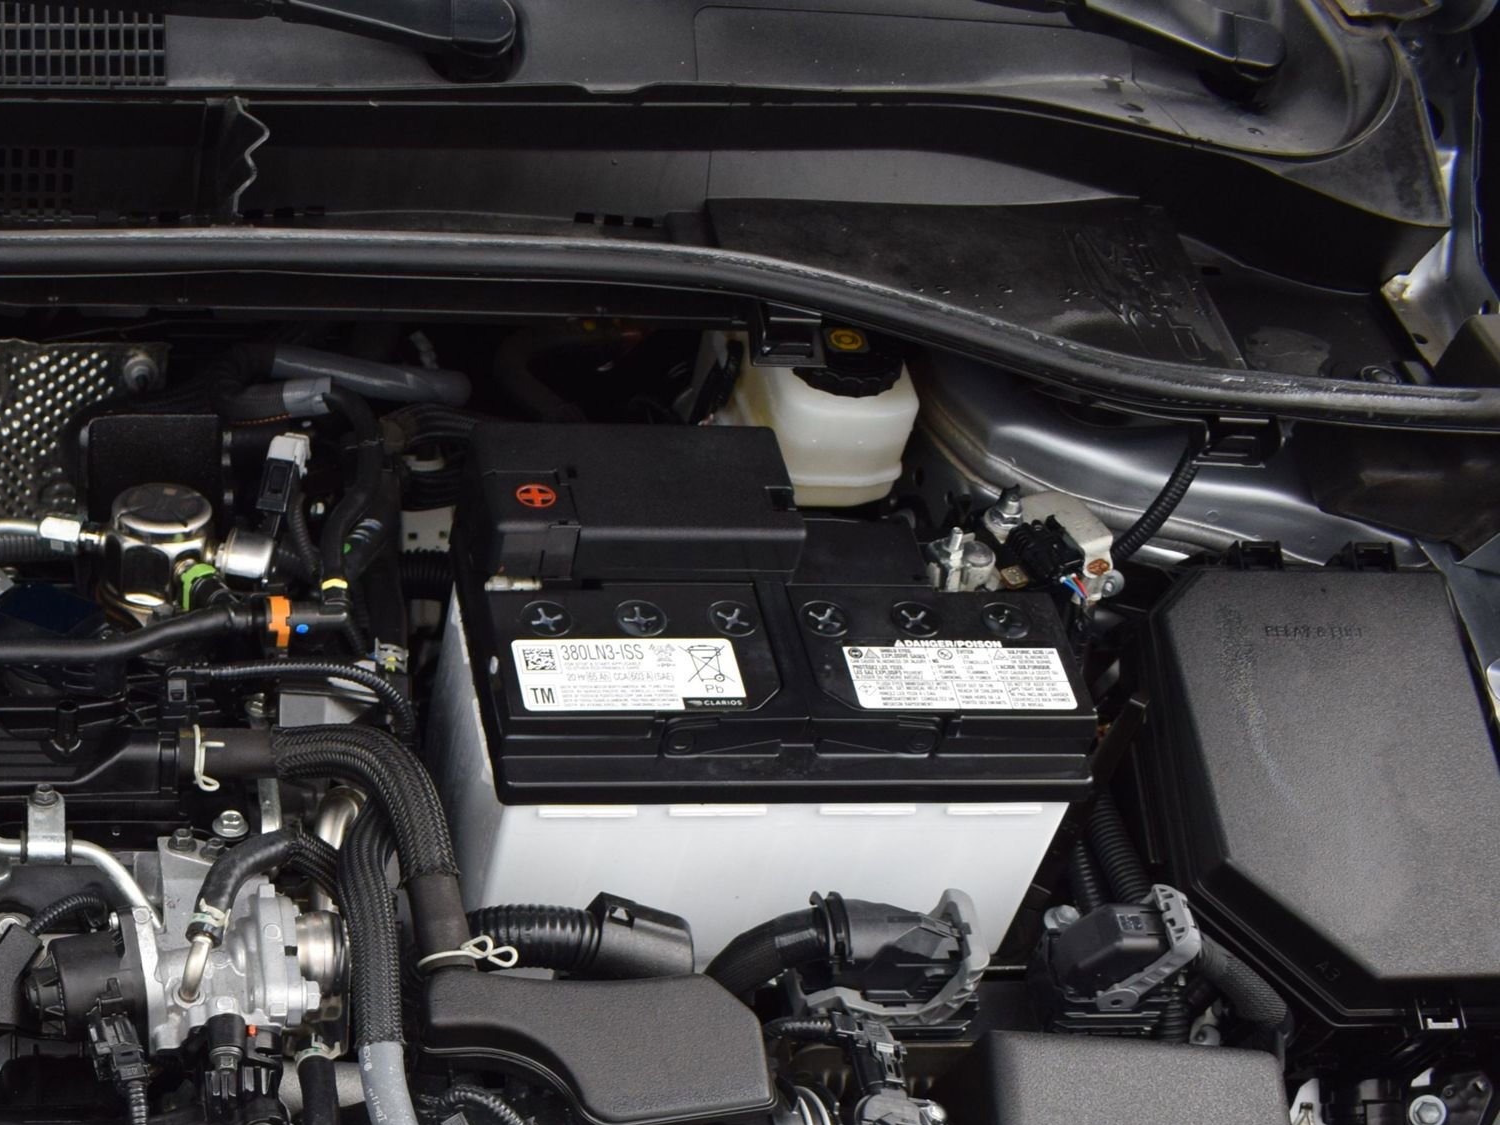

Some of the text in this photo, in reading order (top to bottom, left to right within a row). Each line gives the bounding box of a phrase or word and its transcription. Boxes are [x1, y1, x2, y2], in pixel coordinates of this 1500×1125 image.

[903, 640, 1003, 648] DANGER/POISON
[561, 644, 645, 660] 380LN3-ISS
[530, 687, 556, 704] TM
[705, 684, 725, 694] Pb
